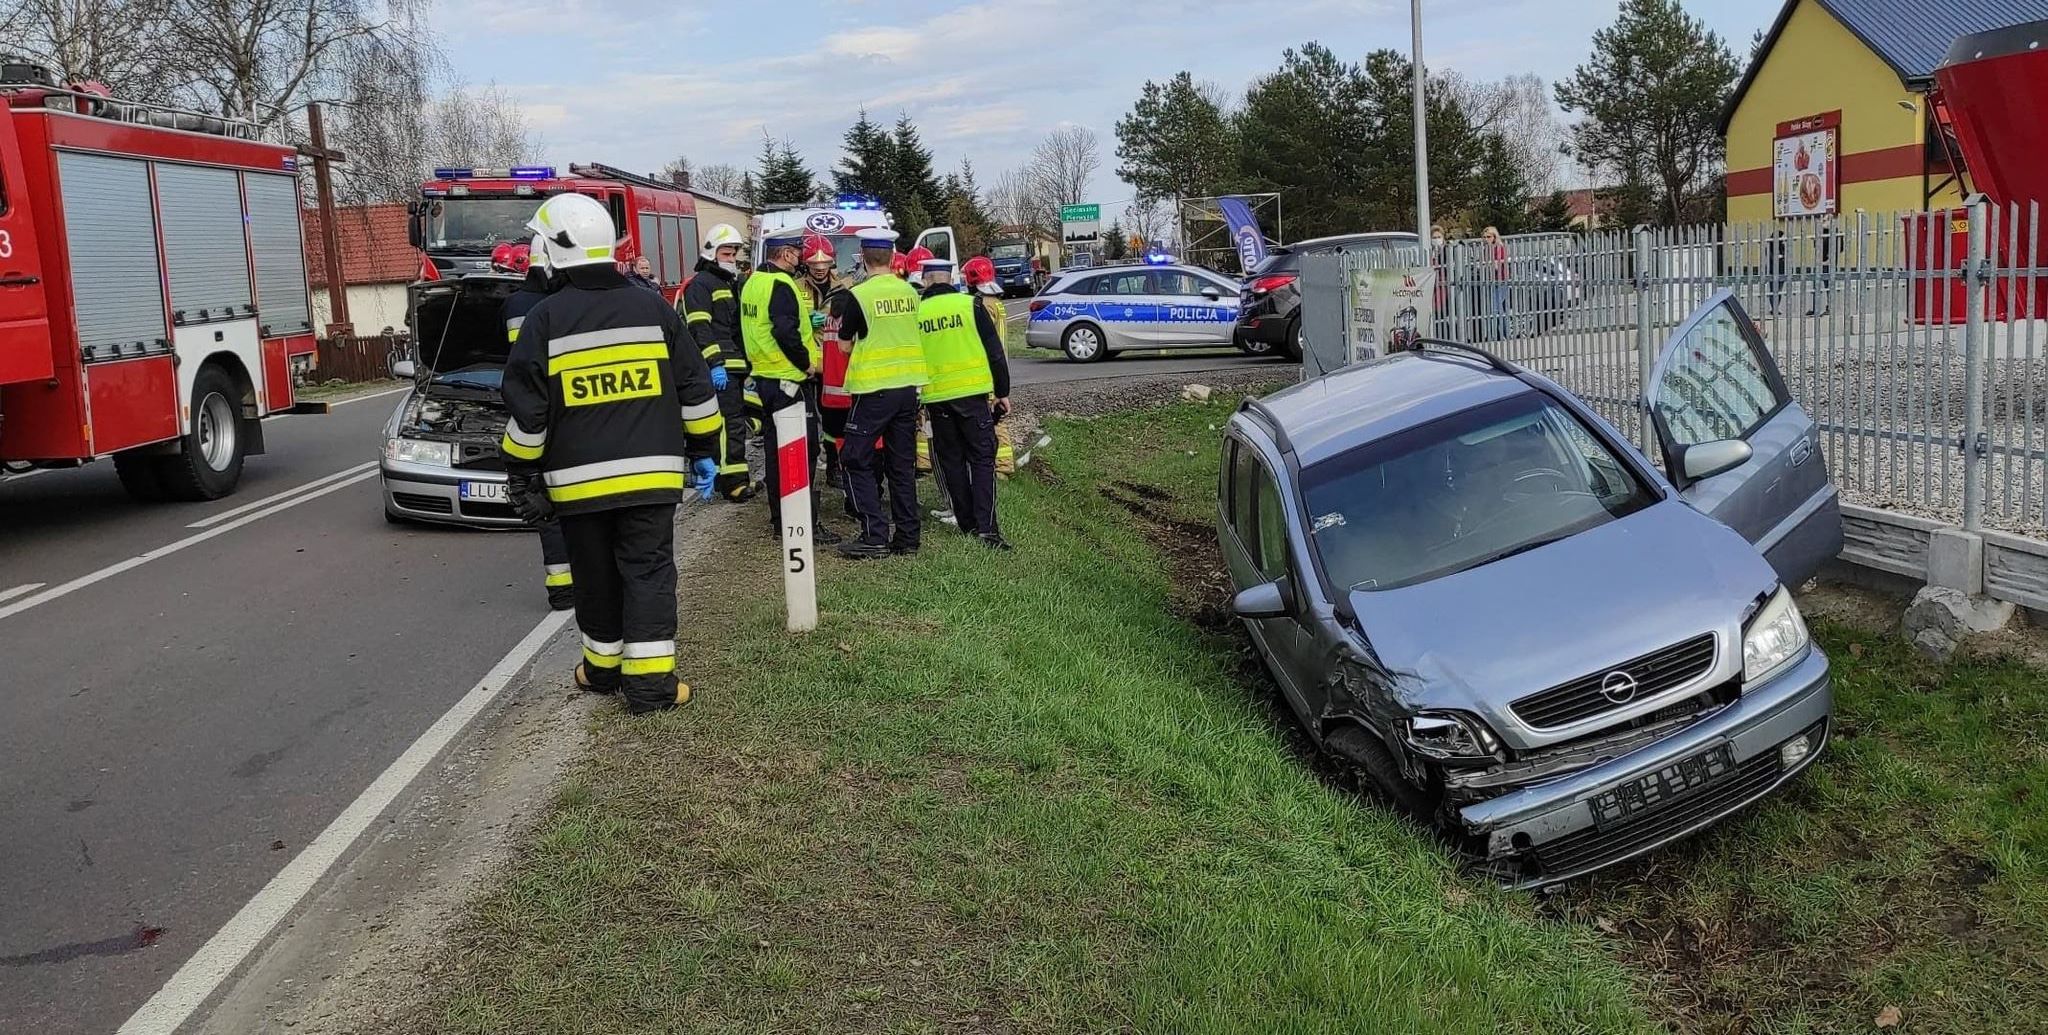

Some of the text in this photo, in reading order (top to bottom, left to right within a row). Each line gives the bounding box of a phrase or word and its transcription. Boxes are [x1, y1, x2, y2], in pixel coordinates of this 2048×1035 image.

[875, 298, 916, 315] POLICJA
[1170, 307, 1218, 320] POLICJA
[469, 483, 497, 498] LLU
[787, 526, 804, 538] 70
[789, 547, 805, 573] 5
